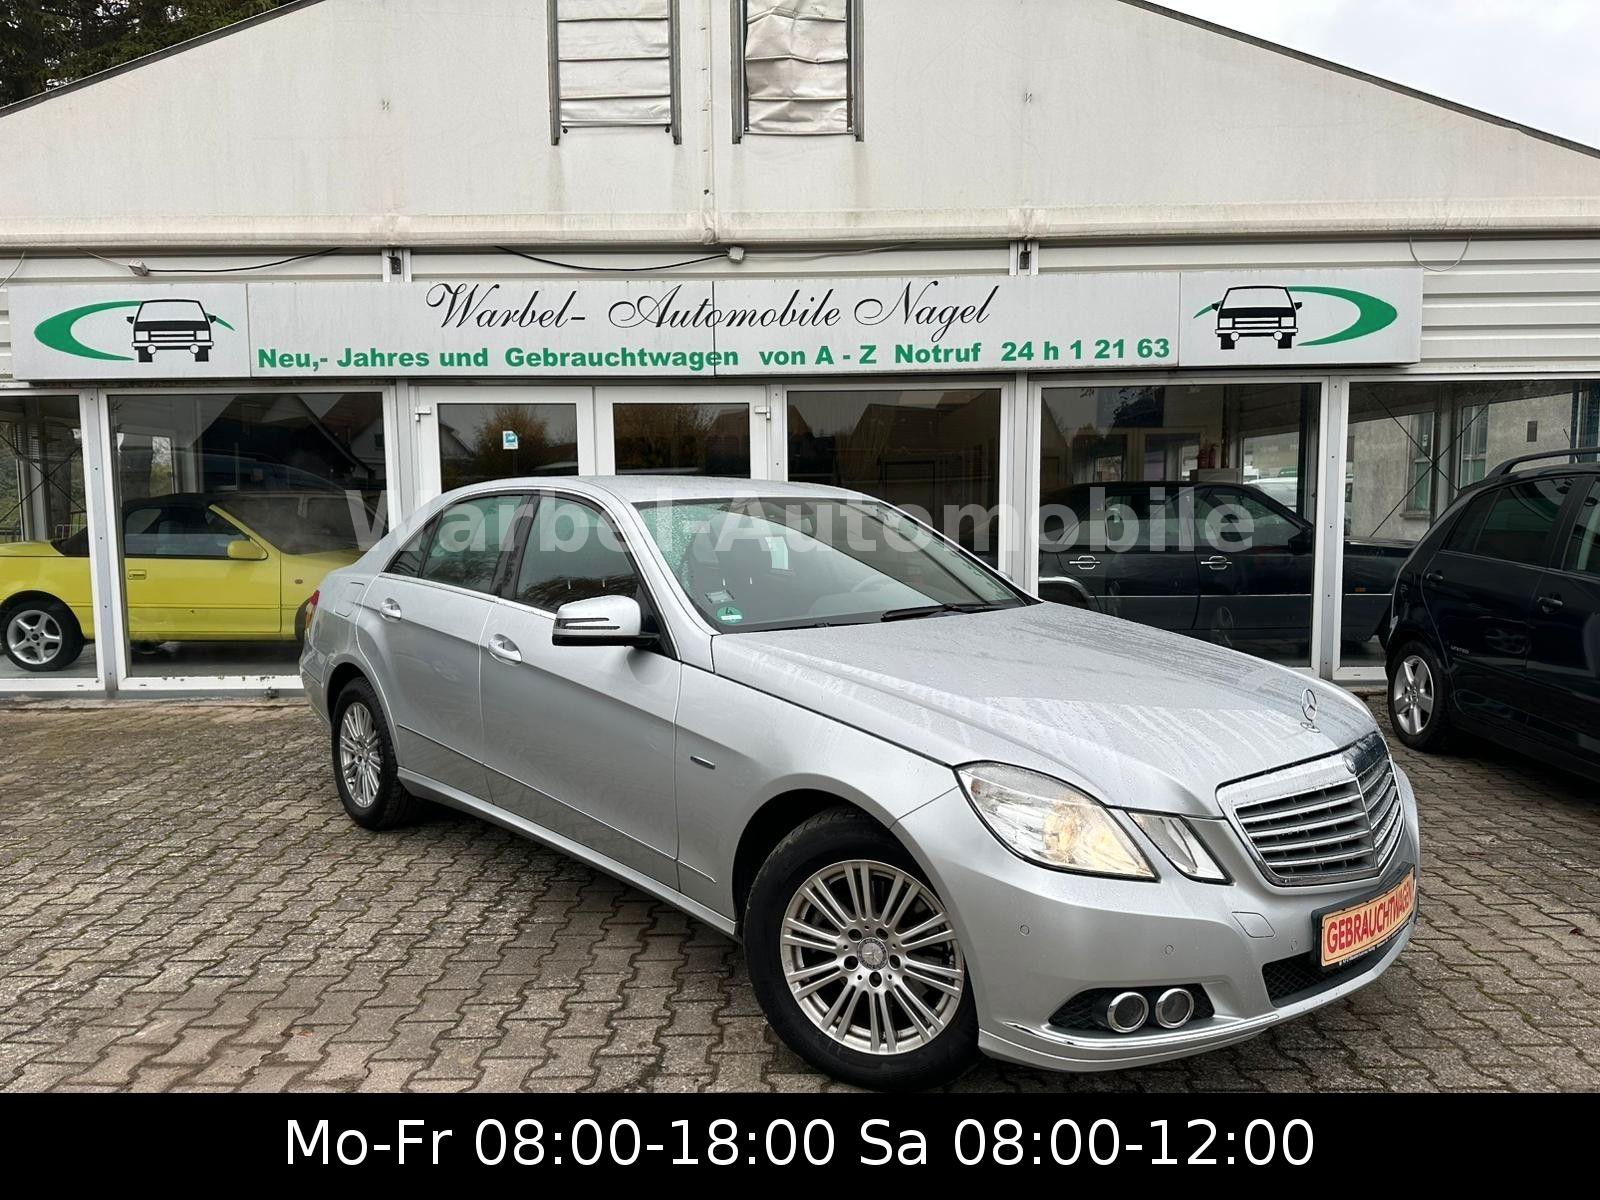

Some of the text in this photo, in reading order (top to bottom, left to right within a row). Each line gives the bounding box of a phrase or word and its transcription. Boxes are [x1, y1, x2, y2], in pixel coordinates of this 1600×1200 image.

[425, 280, 1000, 343] Warbel- Automobile Nagel
[257, 348, 329, 371] Neu,-
[337, 347, 430, 369] Jahres
[439, 347, 489, 368] und
[504, 346, 739, 372] Gebrauchtwagen
[759, 350, 806, 366] von
[815, 345, 834, 365] A
[858, 344, 877, 365] Z
[894, 342, 983, 364] Notruf
[1001, 341, 1034, 362] 24
[1043, 341, 1060, 361] h
[1070, 339, 1082, 360] 1
[1094, 338, 1125, 359] 21
[1137, 337, 1170, 358] 63
[1326, 881, 1413, 954] GEBRAUCHTWAGEN
